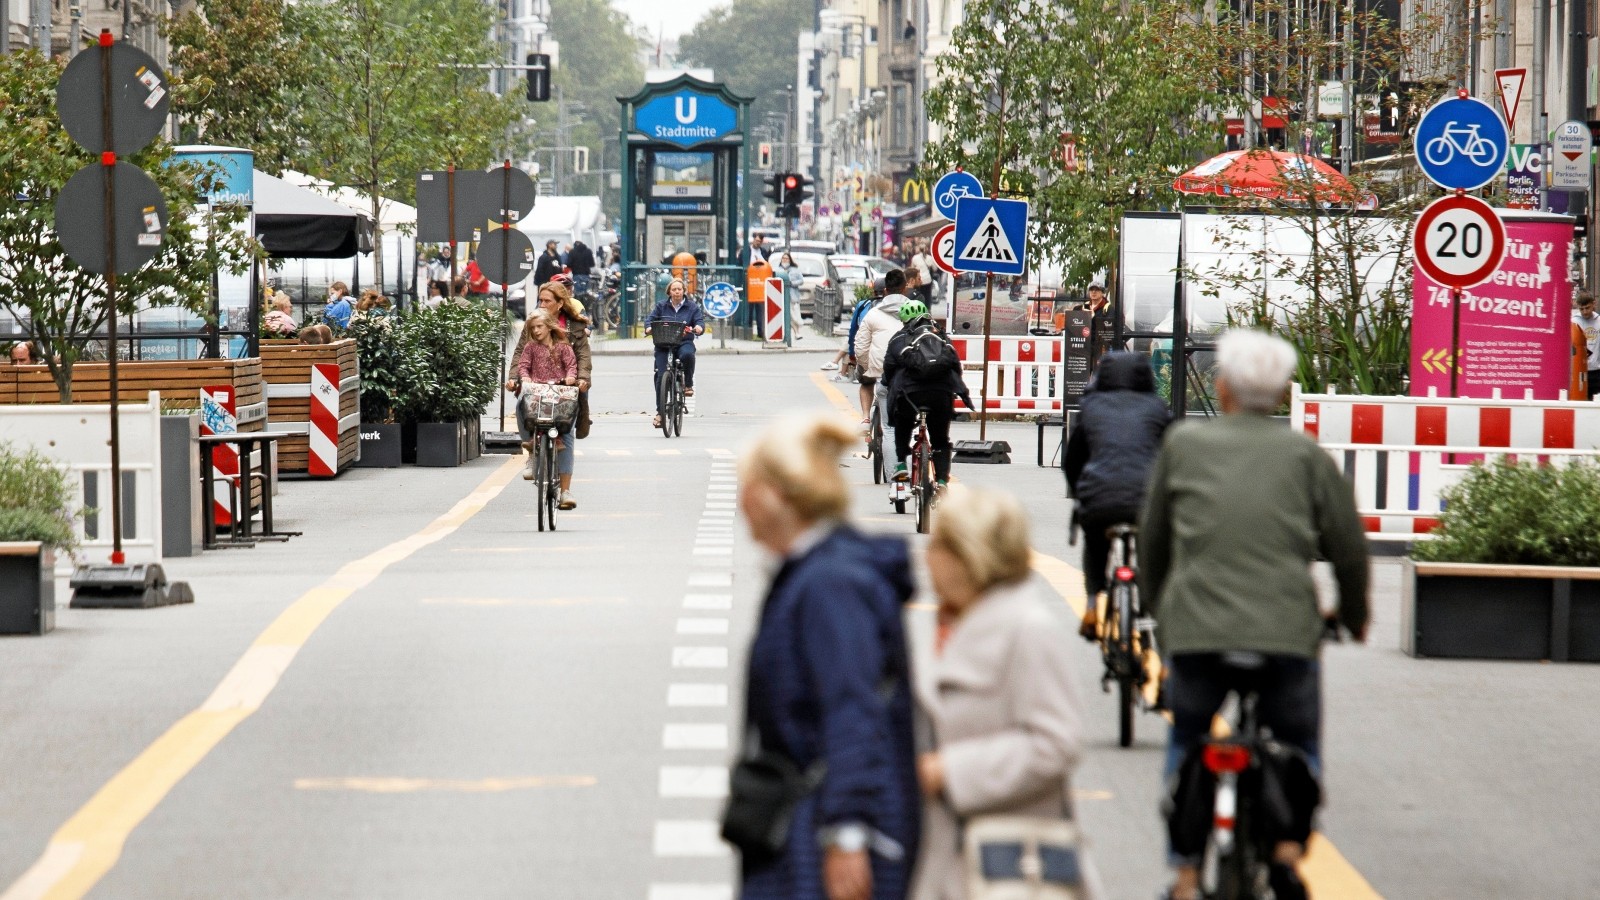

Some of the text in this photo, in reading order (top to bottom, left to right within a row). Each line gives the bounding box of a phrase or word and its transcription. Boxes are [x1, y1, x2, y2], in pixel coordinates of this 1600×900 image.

[675, 96, 697, 124] U
[655, 125, 717, 137] Stadtmitte
[1567, 126, 1578, 134] 30
[1436, 222, 1482, 258] 20
[1504, 238, 1533, 259] für
[1484, 269, 1542, 289] eren
[1428, 286, 1451, 308] 74
